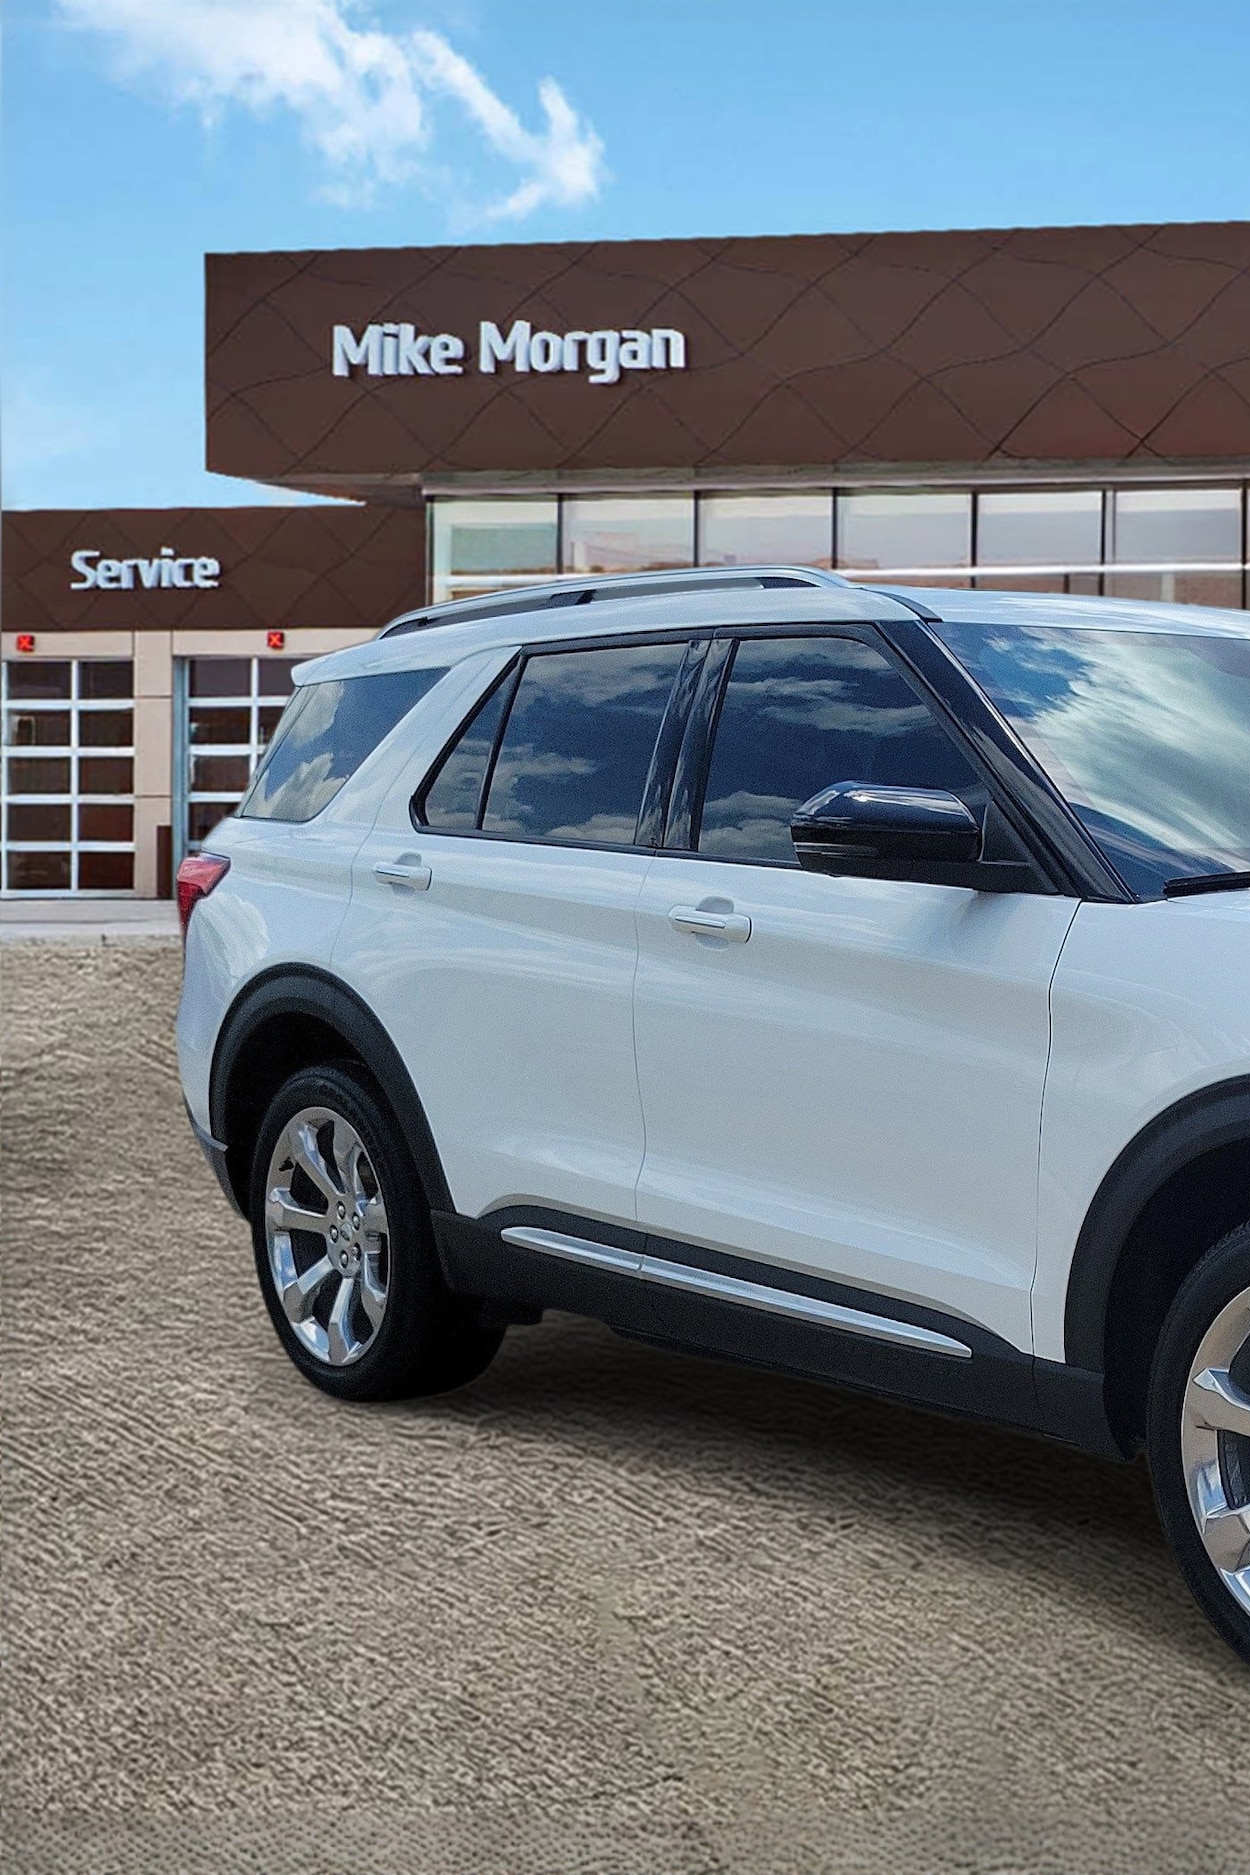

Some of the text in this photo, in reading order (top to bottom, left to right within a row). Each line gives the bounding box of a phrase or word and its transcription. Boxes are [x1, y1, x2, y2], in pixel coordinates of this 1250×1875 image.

[332, 319, 686, 384] Mike Morgan
[70, 547, 220, 589] Service
